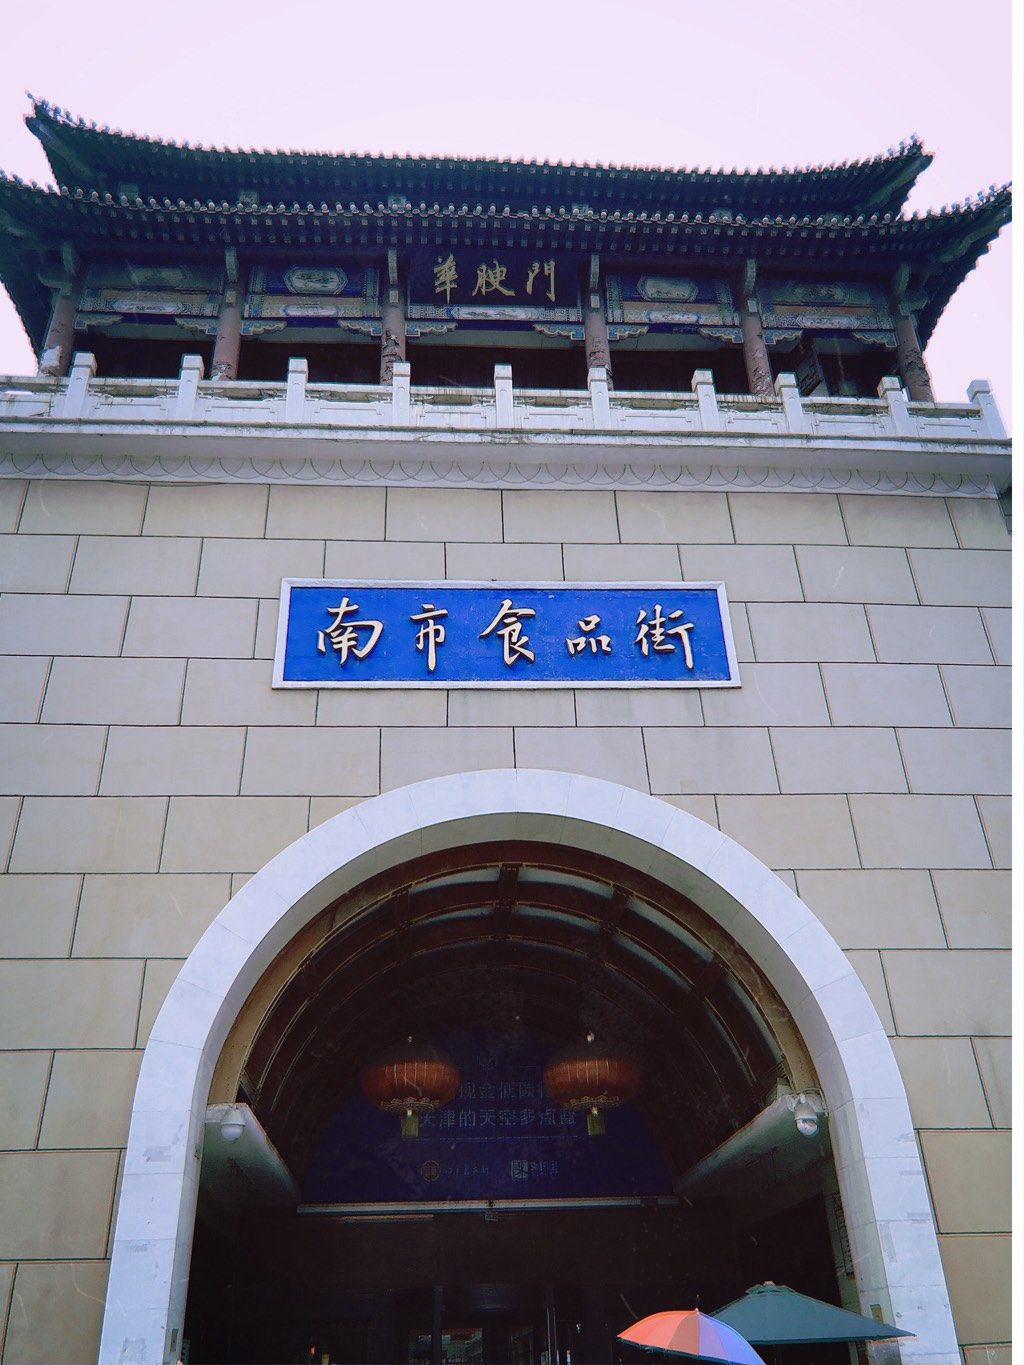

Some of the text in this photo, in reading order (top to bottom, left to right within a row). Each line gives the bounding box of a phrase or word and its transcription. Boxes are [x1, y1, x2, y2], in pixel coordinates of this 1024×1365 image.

[316, 597, 697, 672] 南市食品街
